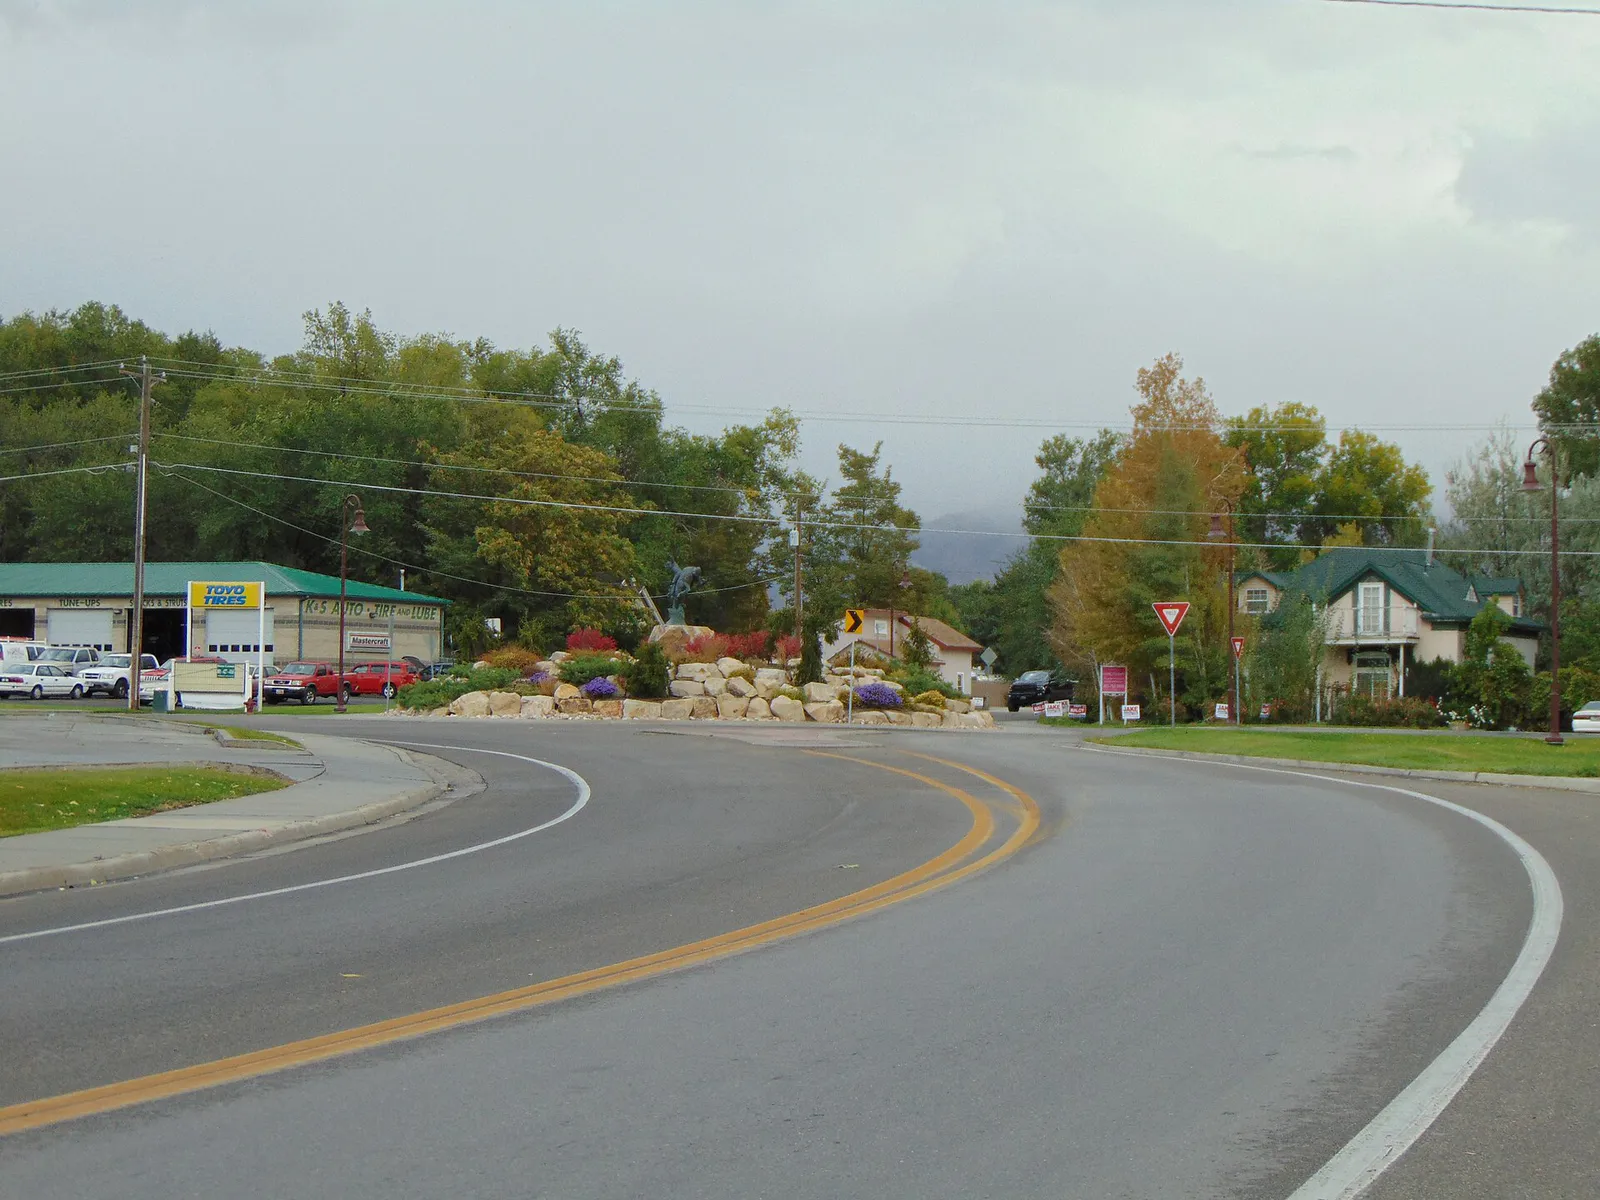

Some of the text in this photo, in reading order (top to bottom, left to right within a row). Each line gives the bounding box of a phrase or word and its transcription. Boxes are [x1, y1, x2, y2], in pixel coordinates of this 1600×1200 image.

[206, 585, 246, 595] TOYO
[59, 599, 101, 607] TUNE-UPS
[129, 599, 155, 607] SCKS
[165, 599, 188, 607] STRUTS
[204, 595, 247, 606] TIRES
[305, 600, 438, 620] K&S AUTO TIRE AND LUBE
[352, 637, 389, 646] Mastercraft
